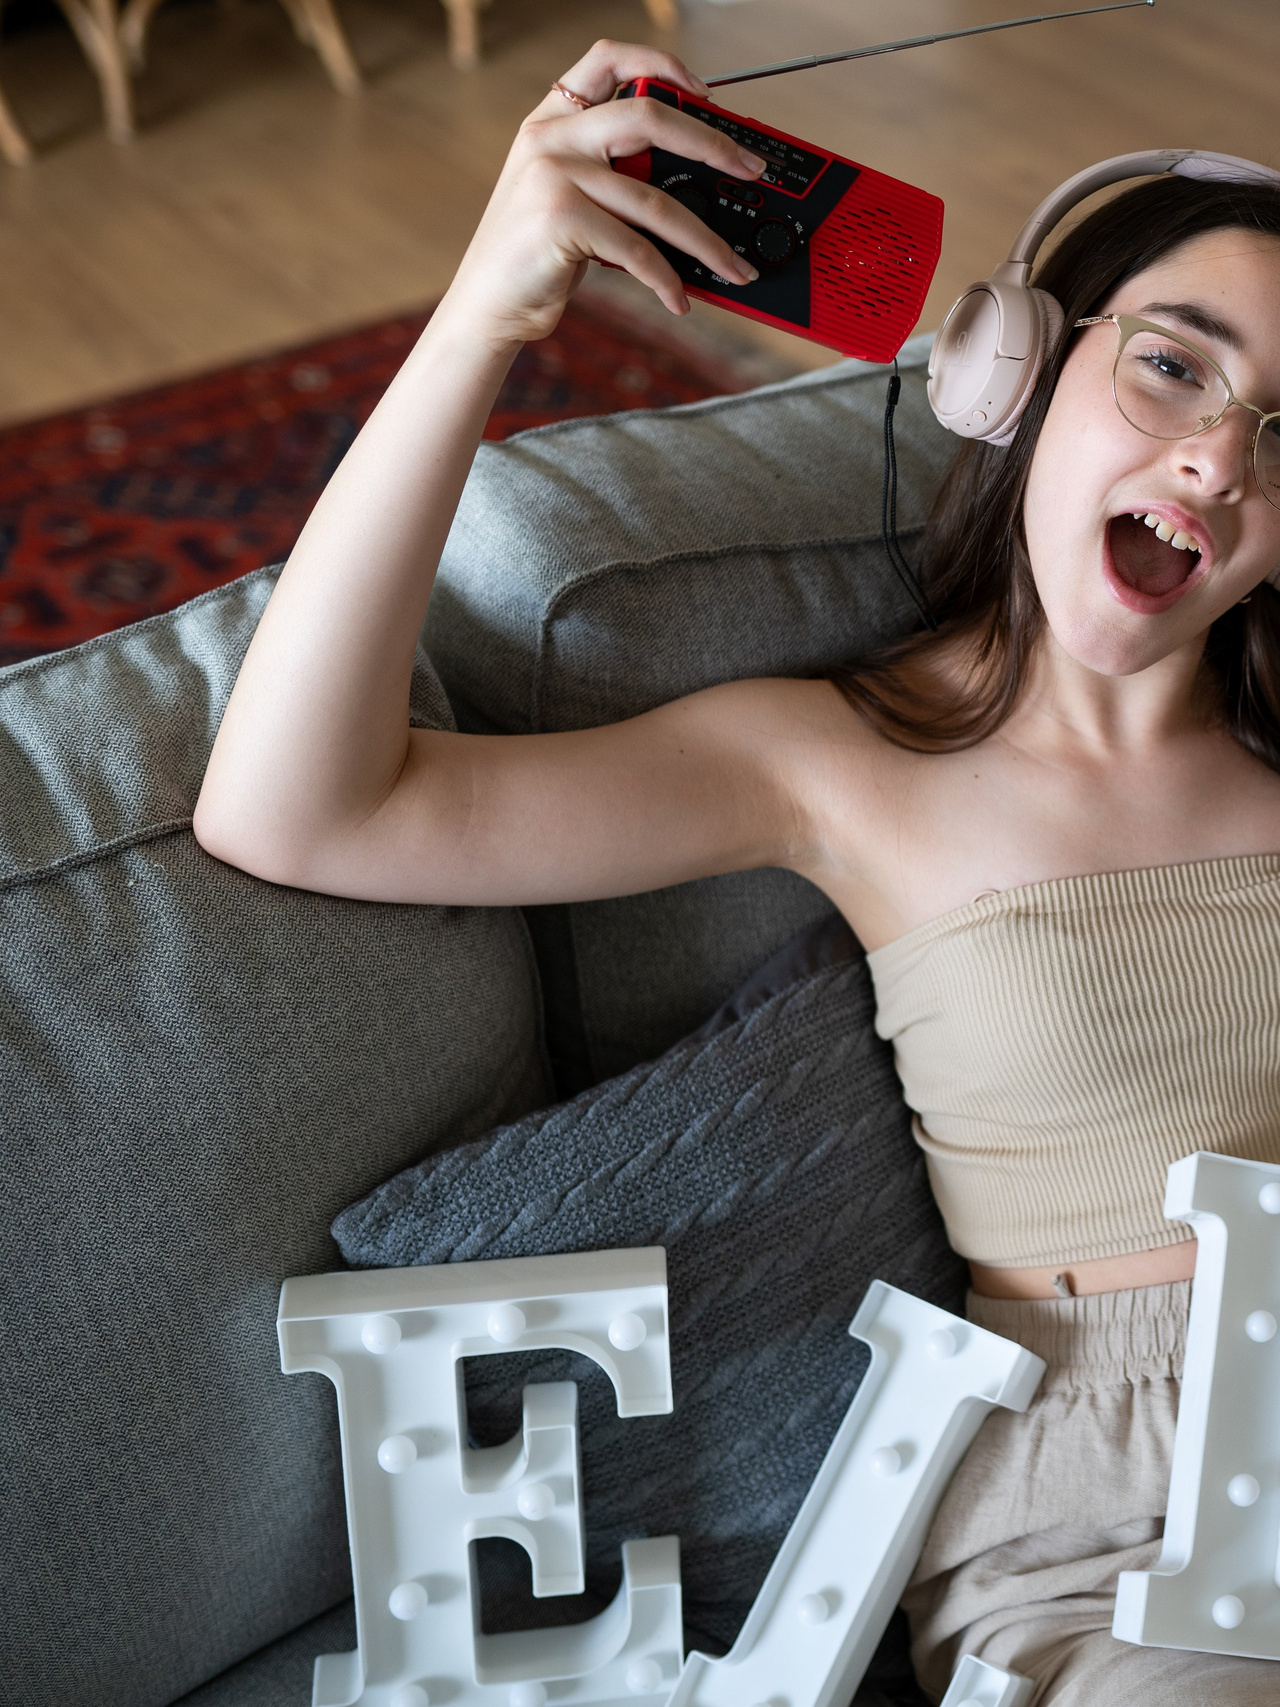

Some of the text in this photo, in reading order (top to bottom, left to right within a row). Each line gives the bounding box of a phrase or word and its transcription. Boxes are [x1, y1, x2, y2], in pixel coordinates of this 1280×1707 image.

[664, 173, 688, 187] TUNING
[718, 197, 756, 218] WB AM FM
[794, 221, 804, 234] VOL
[734, 244, 746, 254] OFF
